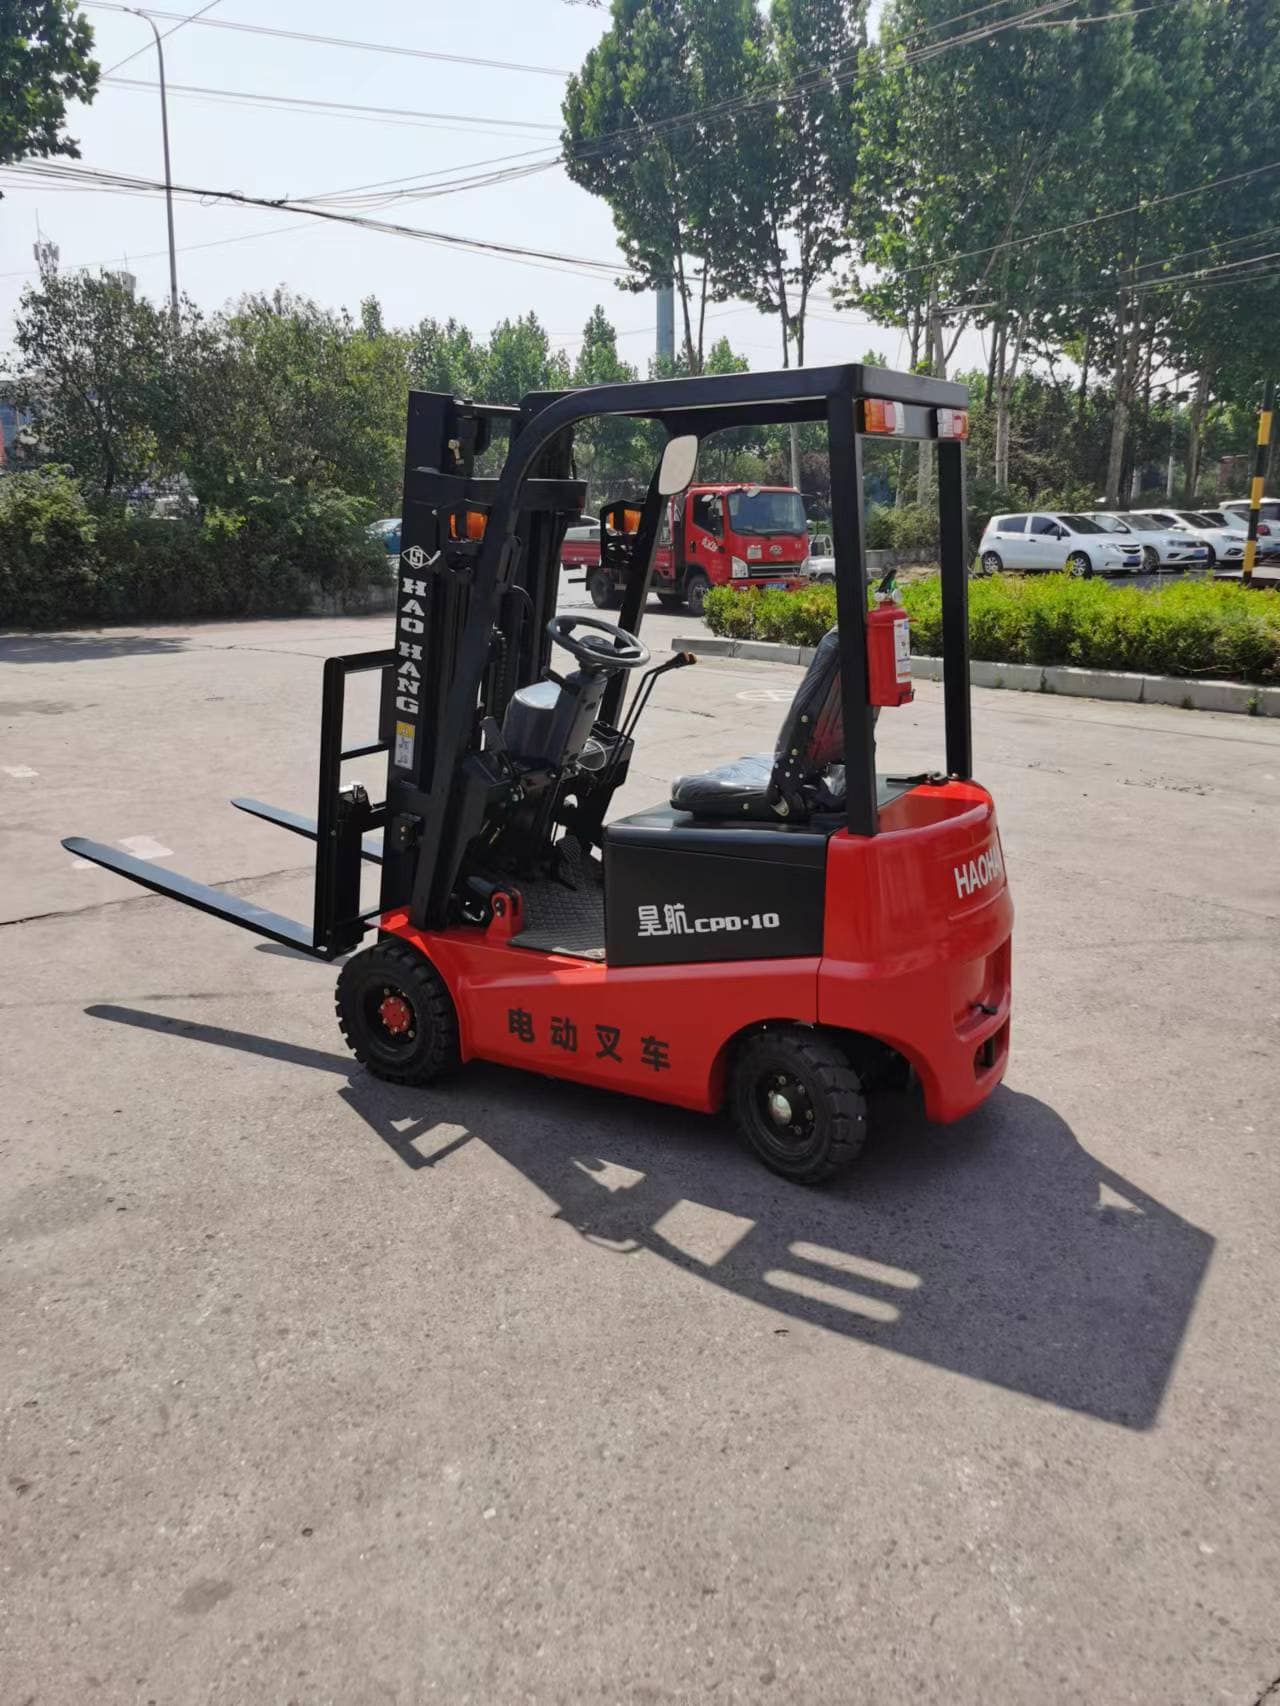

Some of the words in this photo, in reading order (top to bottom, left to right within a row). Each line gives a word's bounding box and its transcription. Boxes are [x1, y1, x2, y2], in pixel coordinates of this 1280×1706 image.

[401, 577, 427, 635] HAO
[395, 641, 423, 715] HANG
[508, 1007, 672, 1072] 电动叉车
